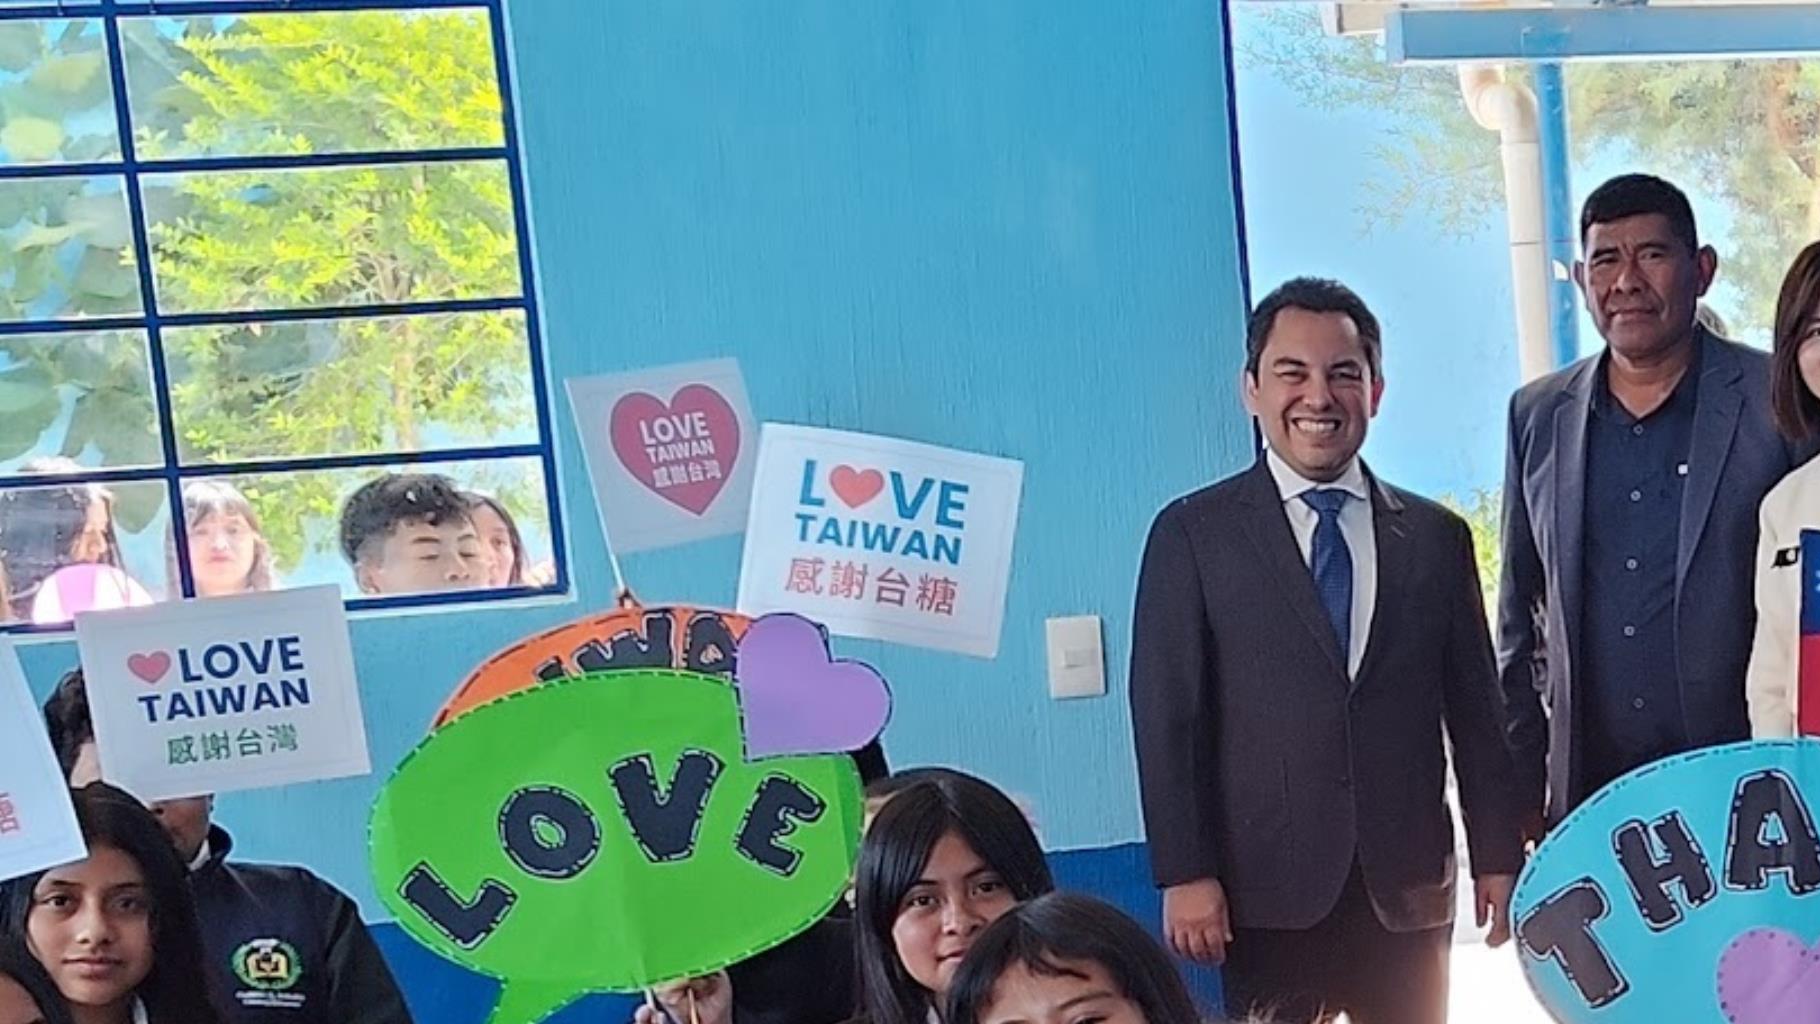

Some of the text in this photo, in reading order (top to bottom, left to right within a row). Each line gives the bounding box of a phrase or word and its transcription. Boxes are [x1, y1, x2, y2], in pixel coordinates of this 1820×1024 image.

[639, 412, 711, 445] LOVE
[646, 438, 716, 464] TAIWAN
[794, 512, 963, 566] TAIWAN
[784, 556, 959, 616] 感謝台糖
[178, 635, 305, 683] LOVE
[138, 677, 311, 724] TAIWAN
[167, 724, 299, 765] 感謝台灣
[397, 747, 828, 951] LOVE
